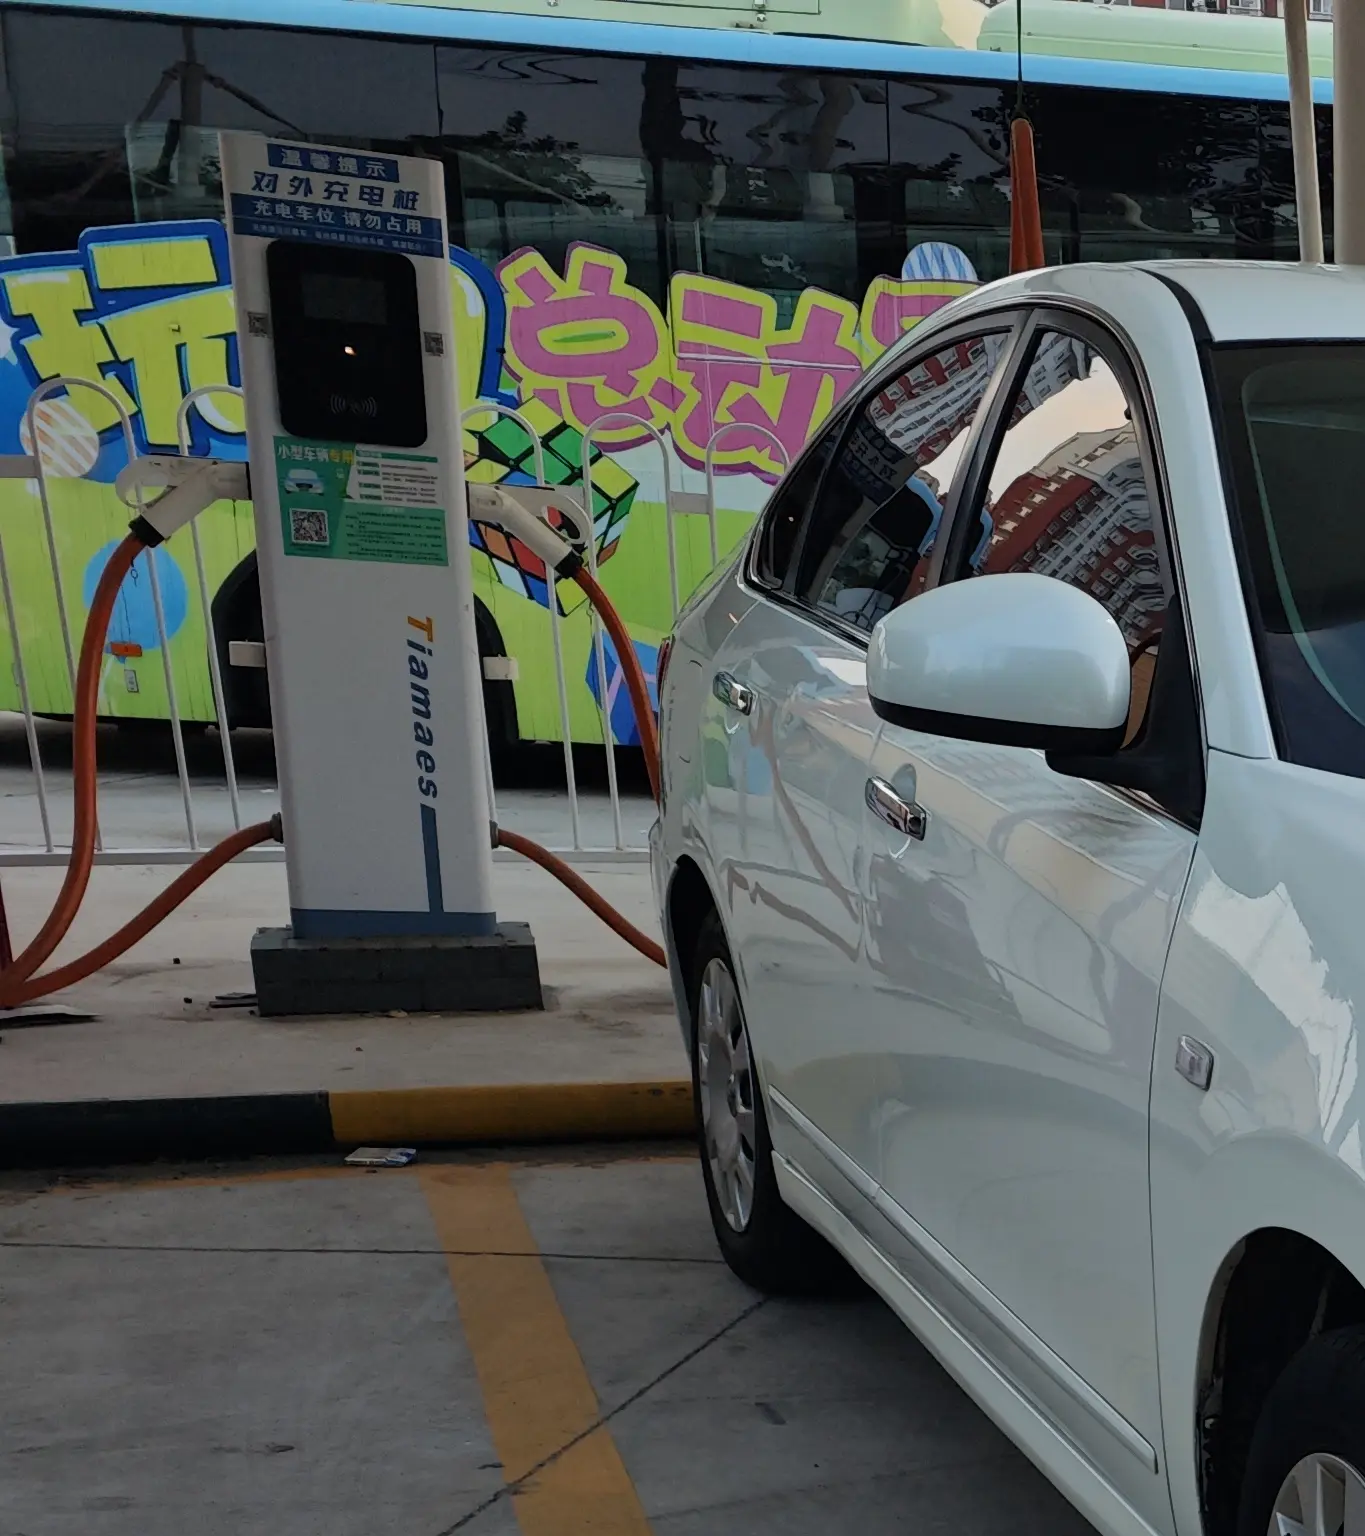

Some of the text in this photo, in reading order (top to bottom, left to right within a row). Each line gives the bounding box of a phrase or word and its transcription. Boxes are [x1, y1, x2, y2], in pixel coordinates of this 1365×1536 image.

[280, 144, 387, 177] 温馨提示
[252, 171, 420, 211] 对外充电桩
[254, 200, 423, 235] 充电车位 请勿占用
[407, 615, 438, 799] Tiamaes
